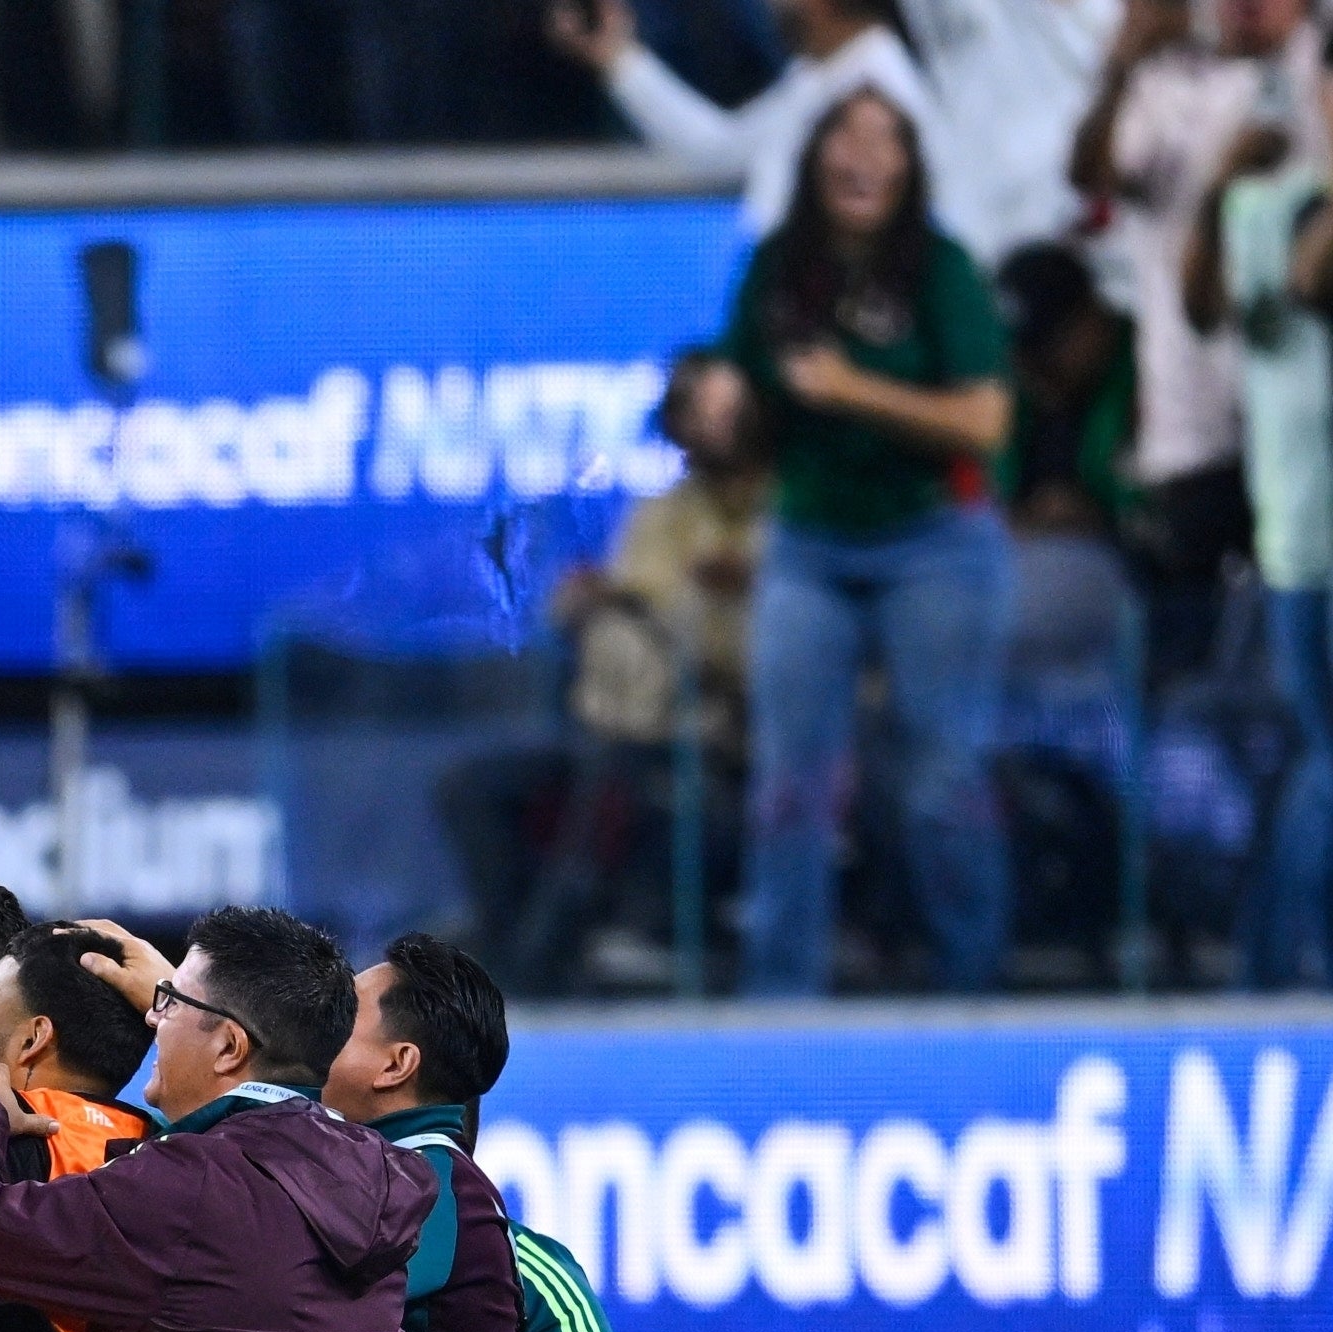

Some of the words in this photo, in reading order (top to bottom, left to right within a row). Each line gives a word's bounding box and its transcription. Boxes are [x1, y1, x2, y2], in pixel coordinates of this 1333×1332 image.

[241, 1084, 269, 1094] LEAGUE
[269, 1088, 291, 1099] FINA
[475, 1052, 1129, 1310] oncacaf
